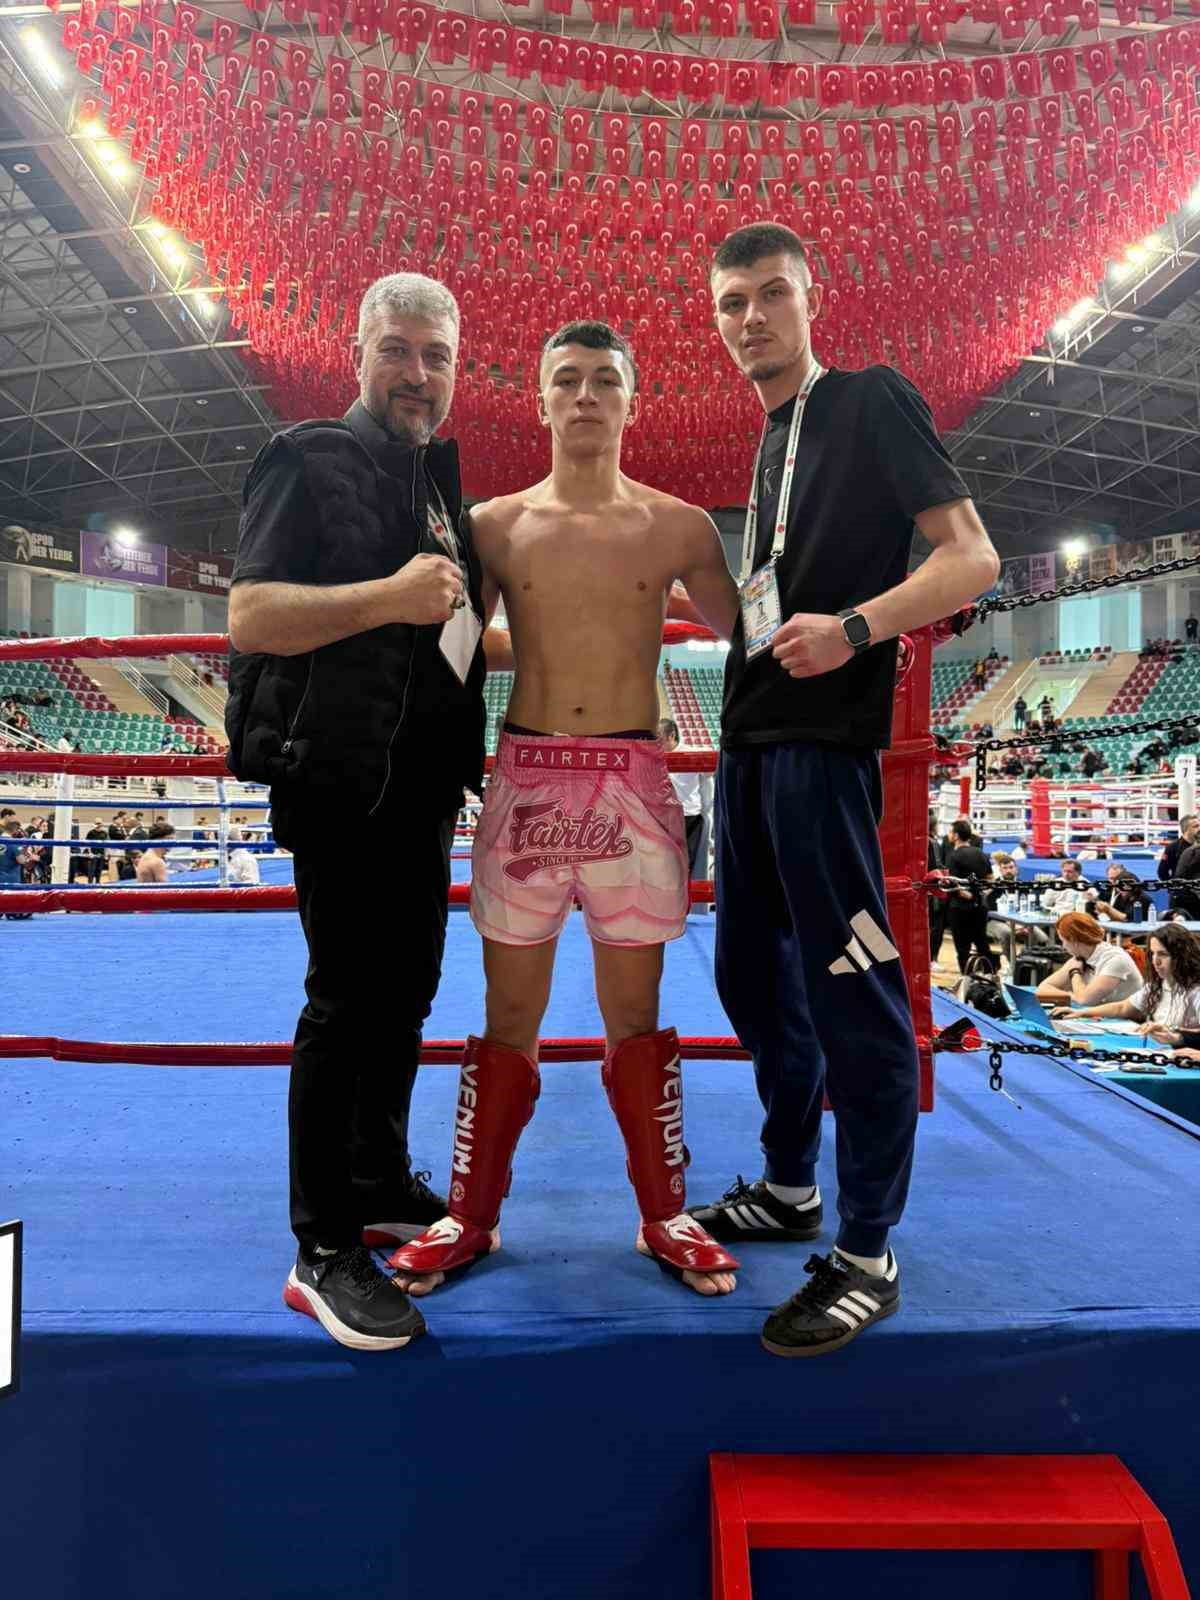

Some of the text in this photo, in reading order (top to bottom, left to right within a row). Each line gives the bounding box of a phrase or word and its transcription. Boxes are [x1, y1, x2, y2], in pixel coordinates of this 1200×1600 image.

[519, 748, 625, 767] FAIRTEX
[509, 797, 633, 857] Fairtex
[452, 1063, 479, 1175] VENUM
[652, 1052, 685, 1167] VENUM
